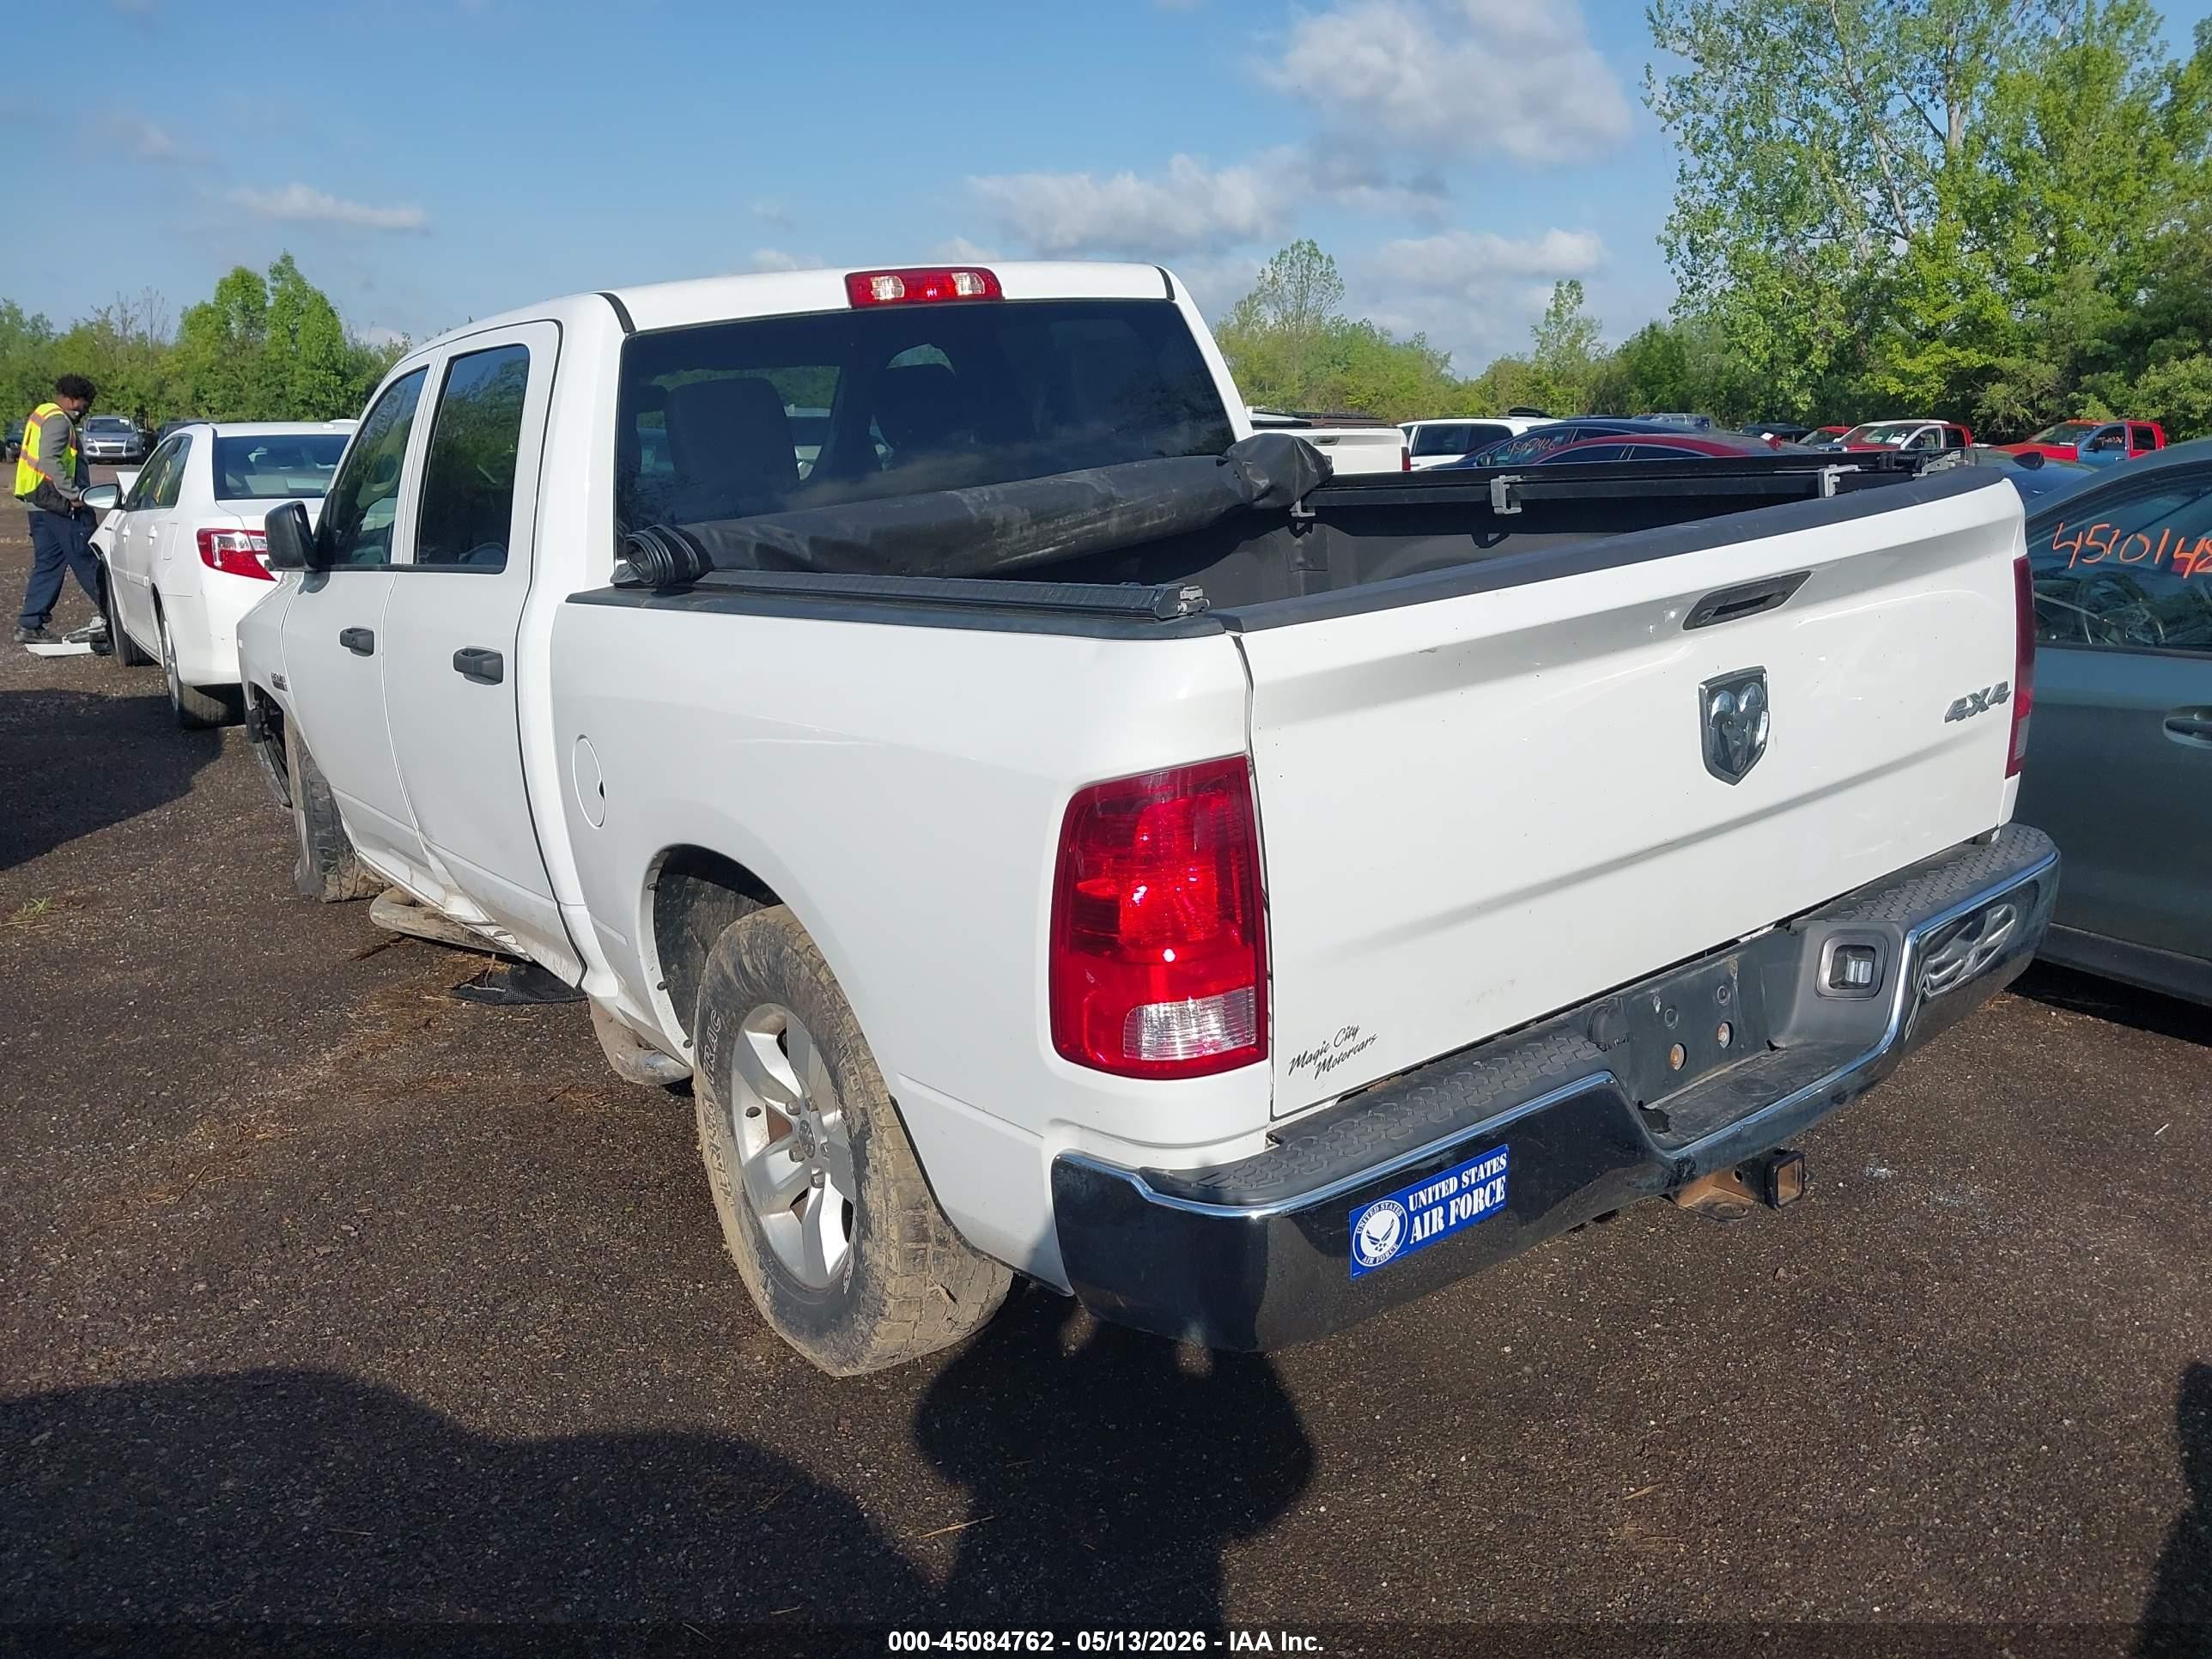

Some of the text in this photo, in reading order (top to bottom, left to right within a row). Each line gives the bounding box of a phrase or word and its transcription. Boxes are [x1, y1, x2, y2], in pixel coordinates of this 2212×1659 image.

[702, 1010, 721, 1085] TRAC
[1288, 1024, 1360, 1076] Magic City
[1315, 1033, 1378, 1079] Motorcars
[1408, 1152, 1507, 1212] UNITED STATES
[1357, 1203, 1403, 1234] UNITED STATES
[1410, 1175, 1506, 1244] AIR FORCE
[1362, 1255, 1375, 1264] AIR
[1376, 1243, 1399, 1263] FORCE
